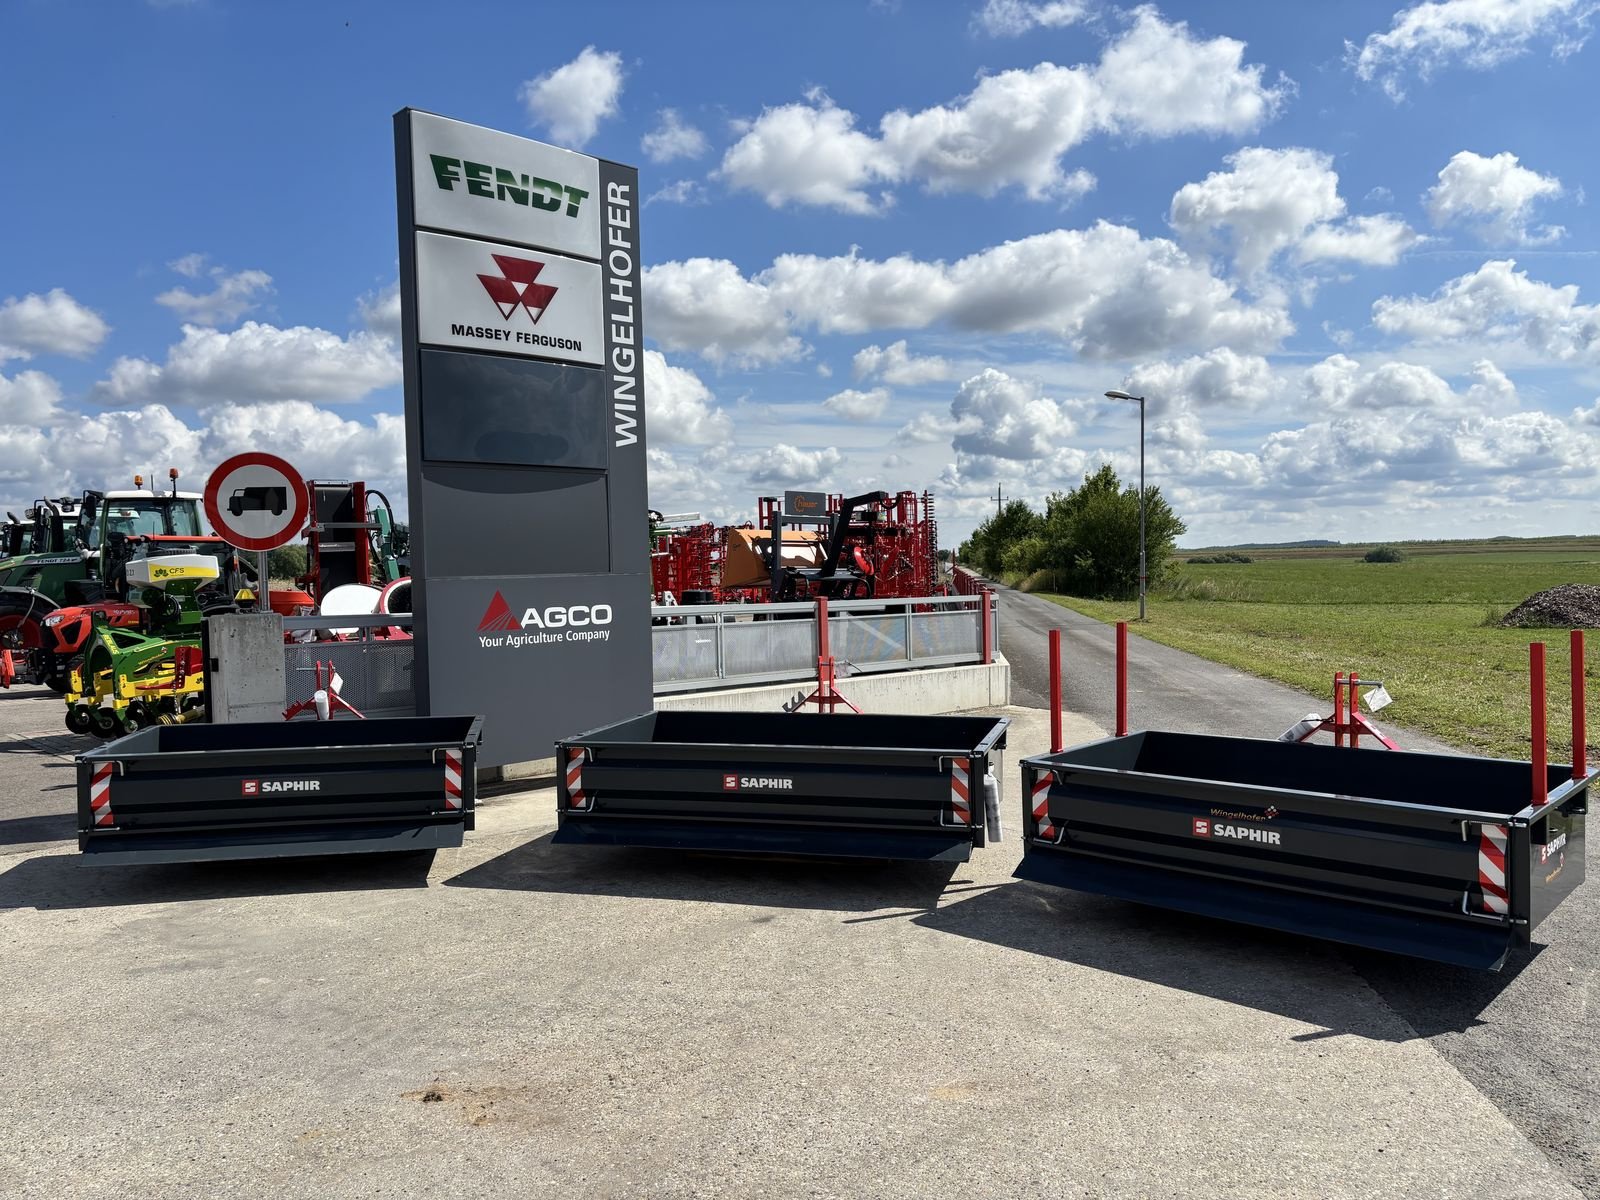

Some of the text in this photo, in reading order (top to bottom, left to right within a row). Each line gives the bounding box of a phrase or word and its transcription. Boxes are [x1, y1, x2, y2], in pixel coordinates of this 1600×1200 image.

[429, 153, 589, 218] FENDT
[607, 181, 638, 447] WINGELHOFER
[451, 323, 582, 351] MASSEY FERGUSON
[520, 604, 613, 629] AGCO
[479, 629, 611, 648] Your Agriculture Company
[262, 780, 321, 792] SAPHIR
[740, 777, 793, 789] SAPHIR
[1213, 823, 1281, 845] SAPHIR
[1546, 832, 1567, 857] SAPHIR
